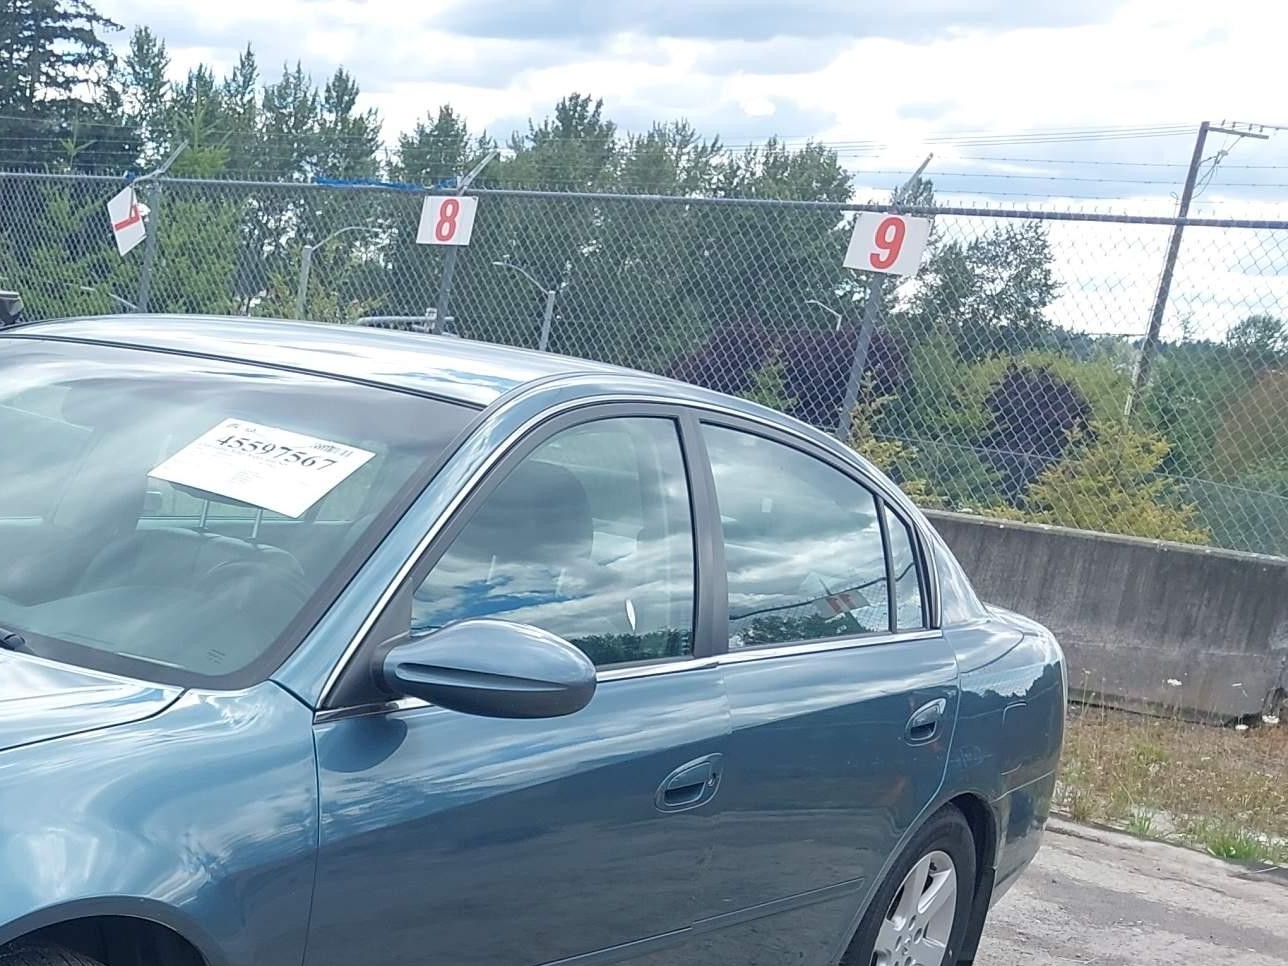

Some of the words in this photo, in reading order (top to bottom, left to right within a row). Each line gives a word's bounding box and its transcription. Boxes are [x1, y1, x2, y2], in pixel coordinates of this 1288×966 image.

[435, 198, 459, 242] 8
[870, 217, 905, 269] 9
[216, 435, 337, 470] 45597567
